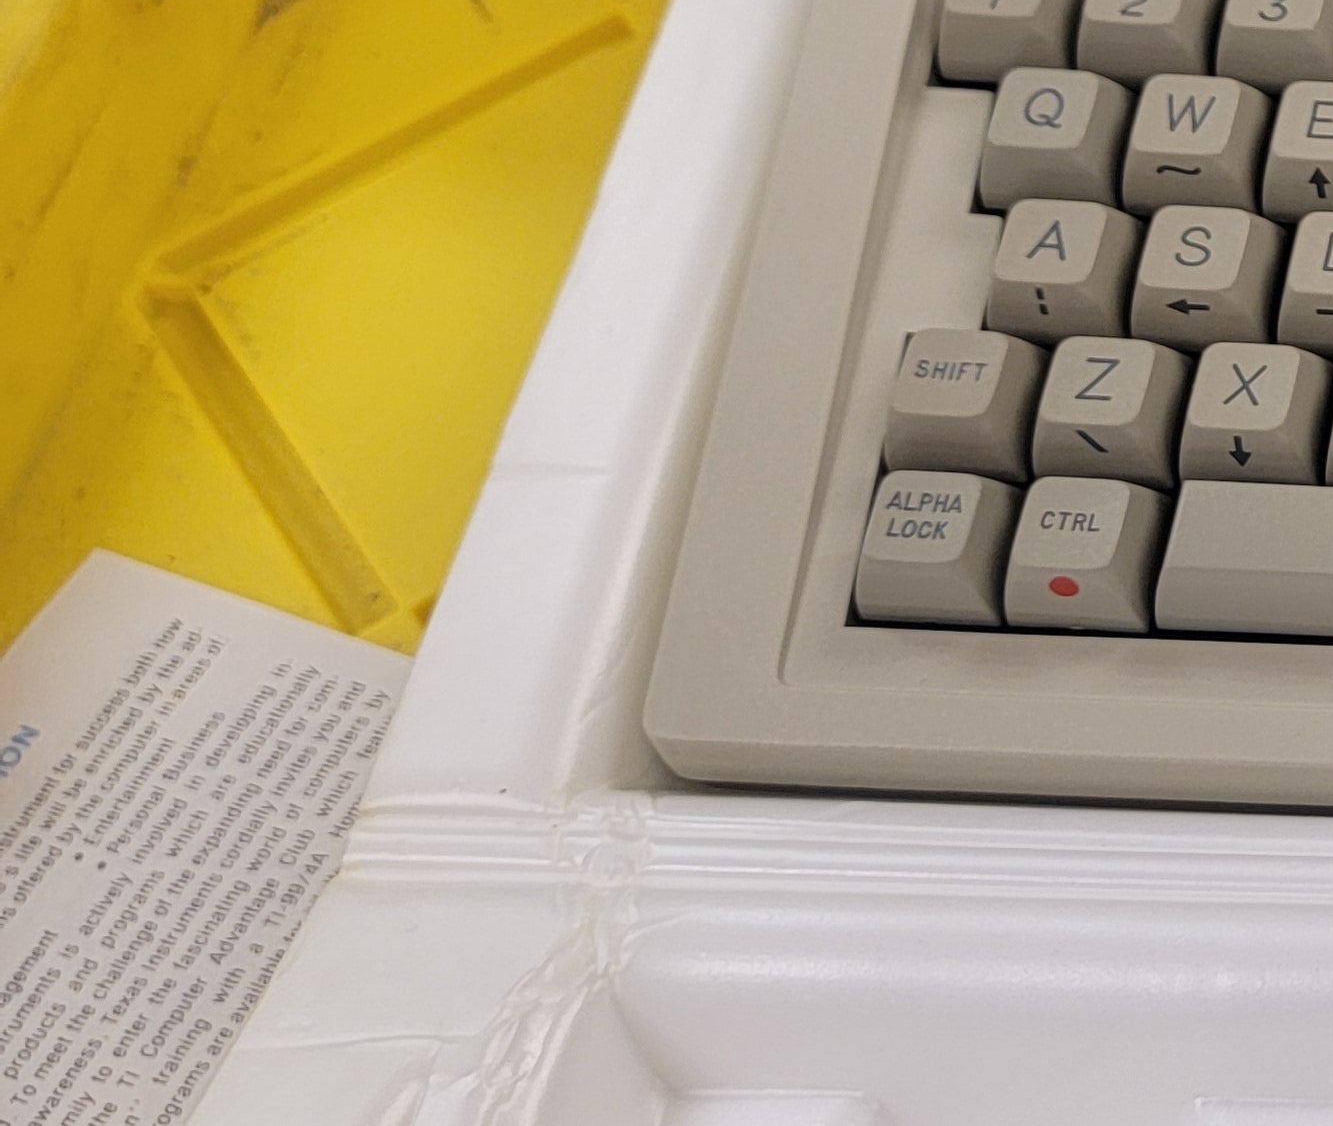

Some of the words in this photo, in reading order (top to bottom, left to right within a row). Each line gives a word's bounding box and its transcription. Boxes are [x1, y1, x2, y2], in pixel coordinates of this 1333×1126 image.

[1023, 87, 1065, 129] Q
[1167, 93, 1217, 134] W
[1025, 219, 1067, 262] A
[1174, 226, 1212, 267] S
[913, 359, 989, 382] SHIFT
[1074, 357, 1121, 402] Z
[1222, 363, 1268, 407] X
[884, 490, 962, 514] ALPHA
[885, 517, 949, 540] LOCK
[1039, 510, 1100, 533] CTRL
[38, 801, 66, 830] will
[61, 778, 87, 798] be
[84, 706, 142, 774] enriched
[136, 683, 163, 703] by
[156, 655, 180, 679] the
[51, 753, 76, 774] for
[75, 689, 129, 750] success
[122, 651, 156, 685] both
[13, 845, 62, 902] offered
[55, 822, 82, 844] by
[74, 794, 103, 819] the
[99, 720, 158, 791] computer
[172, 658, 210, 699] areas
[58, 943, 80, 959] is
[78, 873, 133, 936] actively
[131, 797, 187, 864] involved
[184, 774, 205, 791] in
[205, 685, 277, 767] developing
[82, 737, 173, 845] Entertainment
[105, 785, 165, 854] Personal
[161, 712, 225, 781] Business
[2, 1003, 66, 1080] products
[68, 957, 98, 992] and
[100, 871, 165, 949] programs
[164, 810, 208, 857] which
[210, 774, 236, 801] are
[237, 666, 320, 764] educationally
[90, 1065, 113, 1083] to
[112, 1013, 148, 1058] enter
[147, 977, 177, 1005] the
[172, 880, 251, 970] fascinating
[245, 826, 287, 871] world
[285, 802, 303, 820] of
[303, 717, 369, 797] computers
[363, 690, 391, 710] by
[99, 977, 148, 1023] Texas
[141, 873, 223, 971] Instruments
[219, 800, 277, 869] cordially
[270, 746, 317, 797] invites
[312, 713, 341, 742] you
[337, 680, 366, 711] and
[9, 1083, 37, 1105] To
[33, 1036, 72, 1079] meet
[65, 1004, 96, 1032] the
[92, 920, 158, 1000] challenge
[153, 898, 172, 916] of
[166, 869, 195, 895] the
[191, 783, 262, 865] expanding
[256, 739, 291, 778] need
[283, 716, 308, 736] for
[115, 1069, 140, 1087] TI
[139, 977, 206, 1057] Computer
[209, 878, 279, 965] Advantage
[278, 829, 315, 866] Club
[315, 770, 357, 817] which
[151, 1018, 212, 1084] training
[212, 967, 245, 1003] with
[248, 942, 264, 954] a
[263, 853, 329, 926] TI-99/4A
[206, 1026, 234, 1056] are
